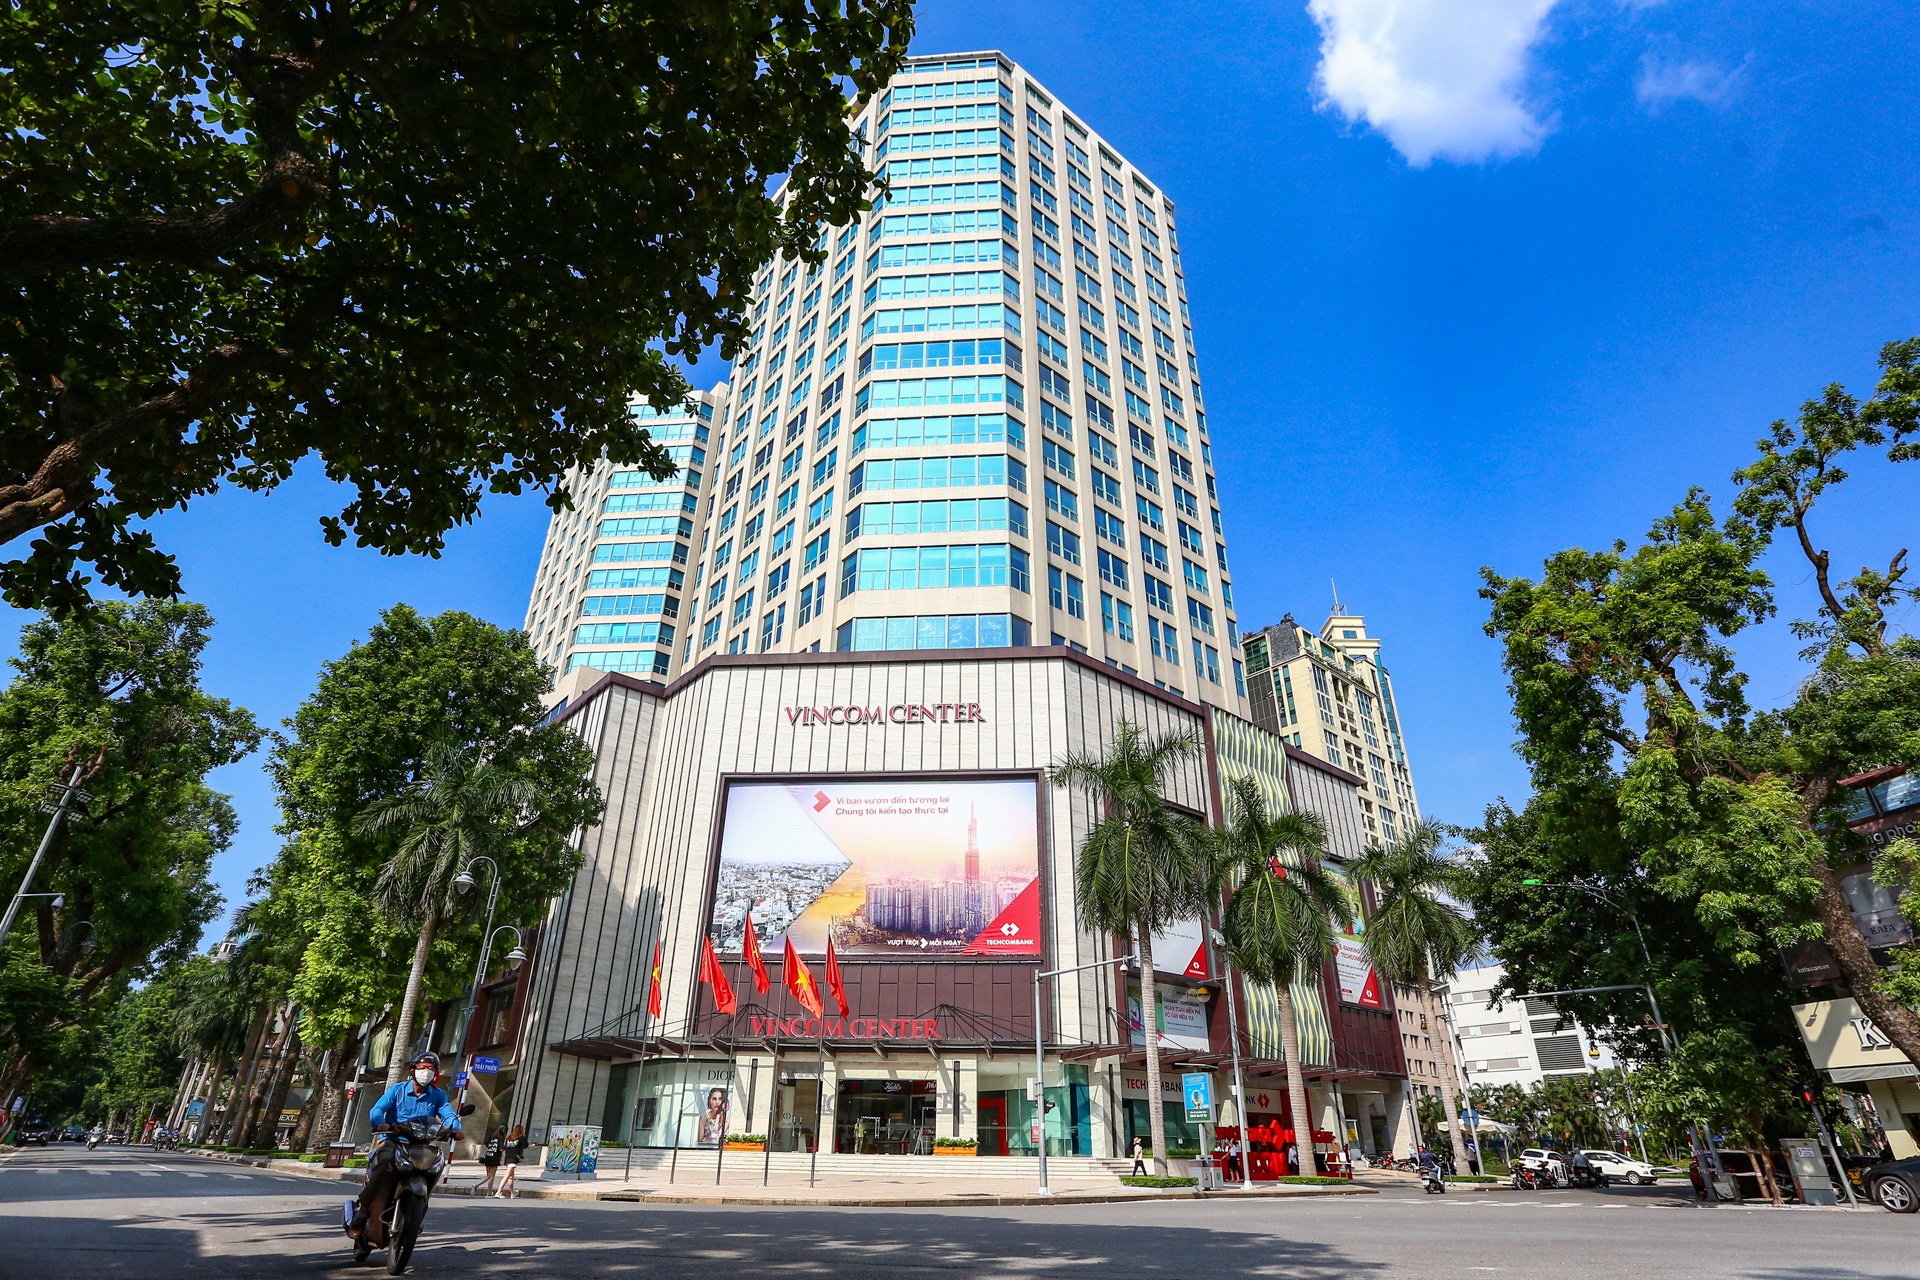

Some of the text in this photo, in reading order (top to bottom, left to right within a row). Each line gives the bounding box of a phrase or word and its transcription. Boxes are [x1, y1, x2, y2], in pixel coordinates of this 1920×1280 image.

[785, 702, 986, 726] VINCOM CENTER
[836, 797, 844, 805] Vì
[846, 797, 862, 807] bạn
[864, 797, 889, 805] vươn
[891, 795, 907, 804] đến
[909, 796, 938, 806] tương
[835, 805, 949, 817] Chúng tôi kiến tạo thực tại
[886, 939, 905, 947] VƯỢT
[905, 939, 919, 947] TRỘI
[943, 938, 962, 946] NGÀY
[750, 1016, 941, 1039] VINCOM CENTER
